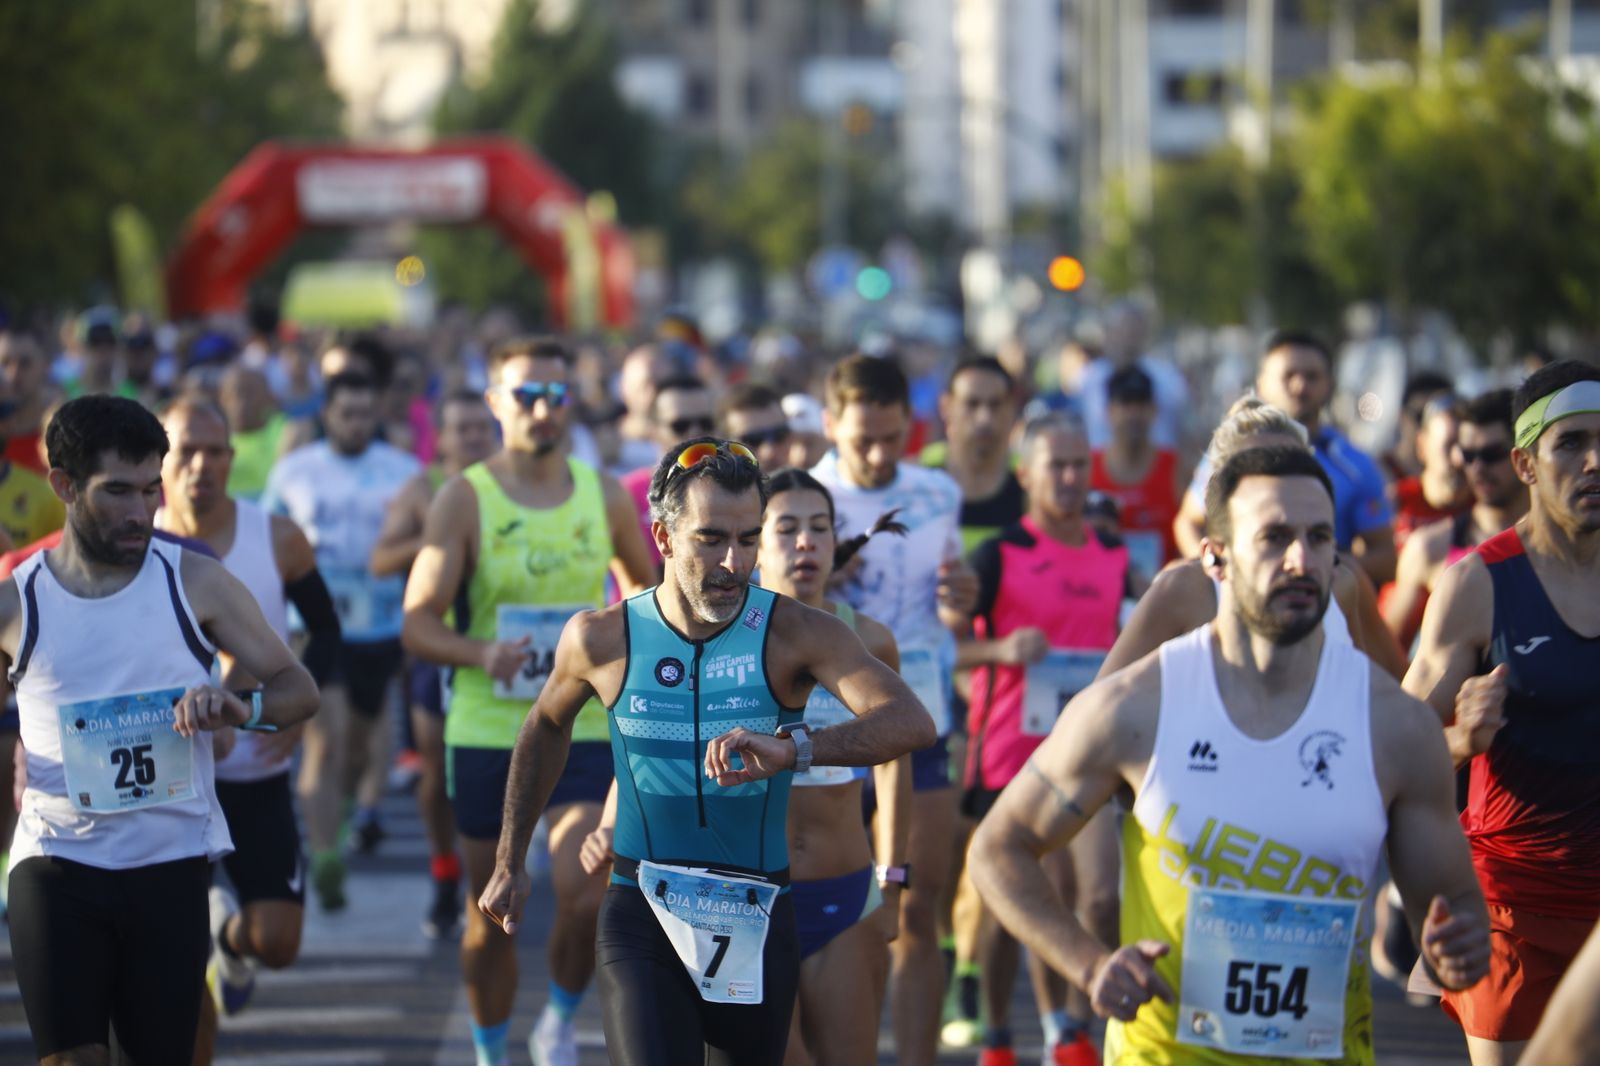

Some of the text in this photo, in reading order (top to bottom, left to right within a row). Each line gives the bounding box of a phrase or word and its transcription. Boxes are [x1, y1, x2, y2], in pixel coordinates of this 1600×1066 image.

[705, 660, 725, 673] GRAN
[66, 719, 113, 736] MDIA
[110, 744, 156, 789] 25
[697, 898, 767, 917] MARATON
[1194, 916, 1257, 940] MEDIA
[703, 934, 731, 979] 7
[1224, 961, 1310, 1020] 554
